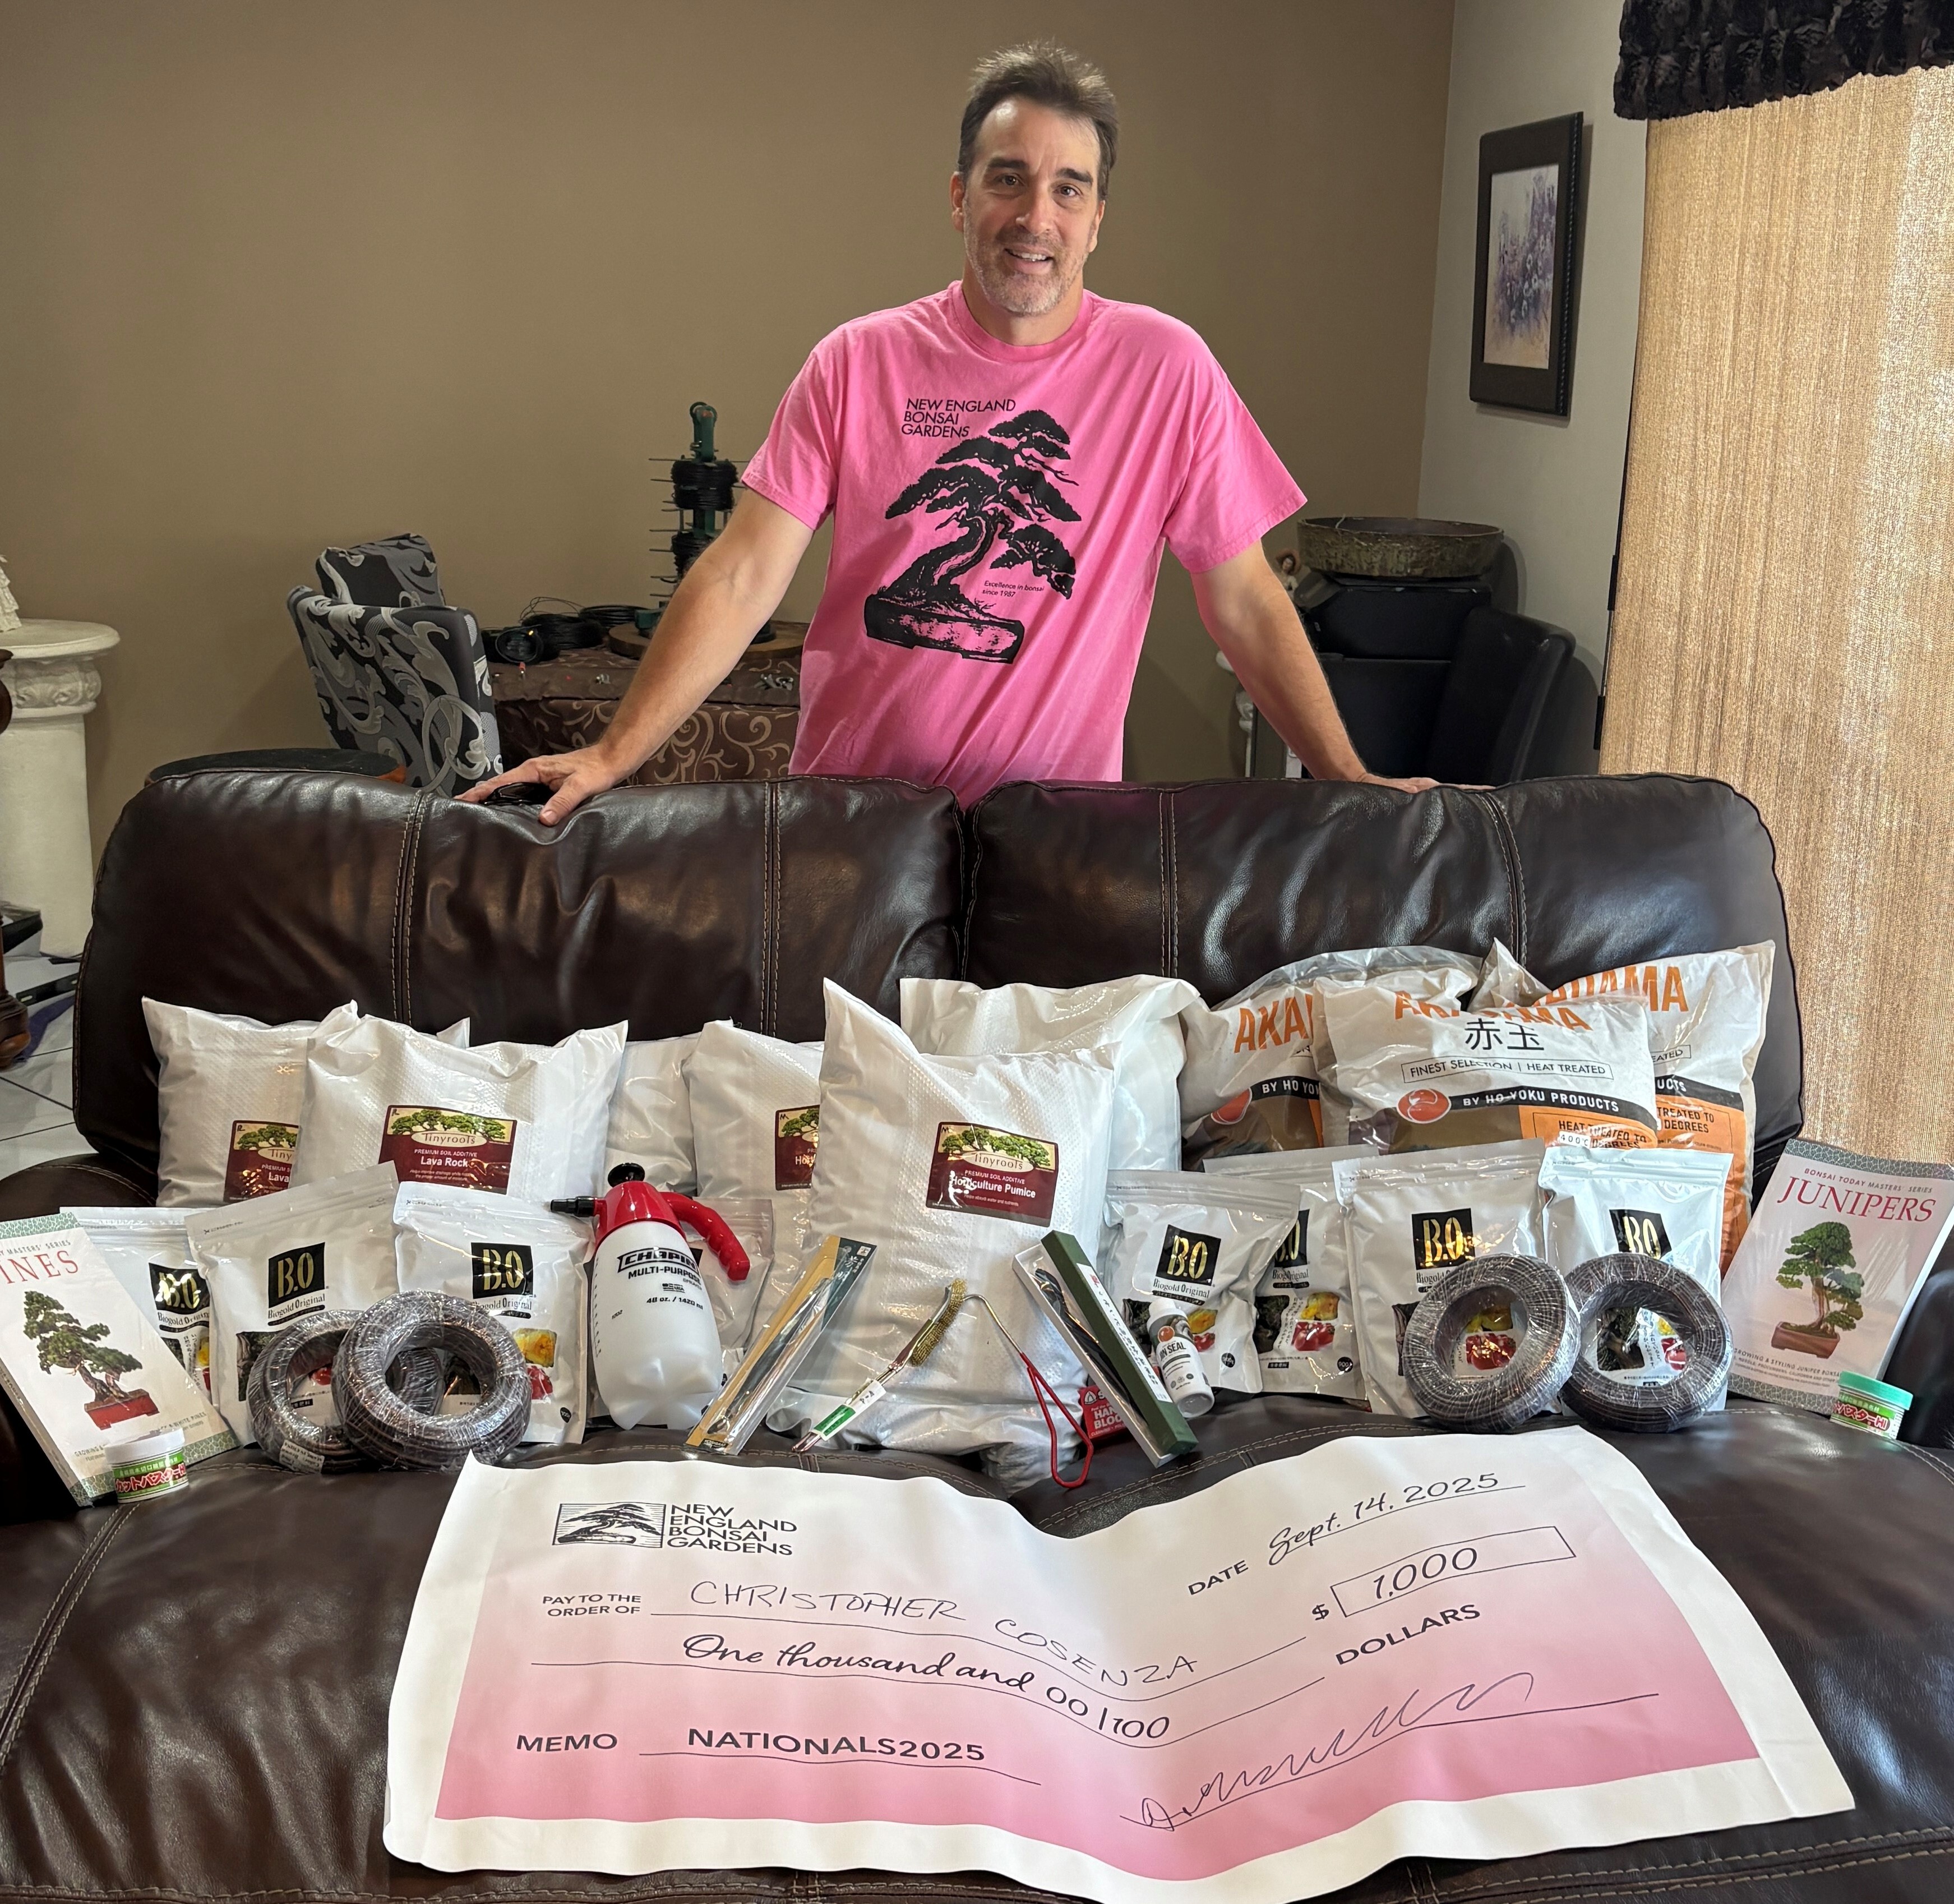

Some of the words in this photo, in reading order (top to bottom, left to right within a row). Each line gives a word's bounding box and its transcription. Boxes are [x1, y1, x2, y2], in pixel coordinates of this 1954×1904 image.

[906, 398, 943, 411] NEW
[945, 399, 1016, 412] ENGLAND
[903, 411, 959, 425] BONSAI
[901, 423, 970, 438] GARDENS
[984, 580, 1016, 589] Excellence
[1464, 1017, 1545, 1050] 赤玉
[1652, 1048, 1683, 1062] EATED
[1410, 1061, 1447, 1078] FINEST
[1450, 1059, 1512, 1071] SELECTION
[1527, 1063, 1554, 1072] HEAT
[1557, 1063, 1606, 1074] TREATED
[1262, 1081, 1277, 1094] BY
[1282, 1080, 1299, 1091] HO
[1302, 1081, 1319, 1095] YO
[1657, 1077, 1687, 1092] UCTS
[1463, 1096, 1479, 1107] BY
[1486, 1094, 1504, 1104] HO
[1510, 1089, 1545, 1101] YOKU
[1550, 1092, 1619, 1113] PRODUCTS
[1657, 1107, 1700, 1120] TREATED
[1703, 1112, 1715, 1123] TO
[1558, 1120, 1585, 1132] HEAT
[1633, 1133, 1647, 1144] TO
[1664, 1119, 1710, 1133] DEGREES
[421, 1132, 477, 1145] Tinyroots
[267, 1149, 293, 1161] Tiny
[421, 1155, 442, 1167] Lava
[445, 1156, 468, 1168] Rock
[973, 1152, 1024, 1170] Tinyroots
[268, 1172, 289, 1183] Lava
[964, 1169, 989, 1179] PREMIUM
[990, 1173, 1001, 1181] SOIL
[1002, 1175, 1025, 1185] ADDITIVE
[1804, 1168, 1836, 1181] BONSAI
[1838, 1175, 1867, 1187] TODAY
[951, 1175, 1003, 1193] Horticulture
[1004, 1183, 1037, 1198] Pumice
[1777, 1176, 1937, 1223] JUNIPERS
[45, 1239, 72, 1250] SERIES
[1622, 1215, 1661, 1260] BO
[624, 1250, 698, 1271] CHAPIN
[1167, 1234, 1208, 1279] B.O
[277, 1252, 315, 1298] B.O
[483, 1248, 525, 1290] B.O
[628, 1265, 702, 1285] MULTI-PURPOSE
[1153, 1278, 1180, 1292] Biogold
[1181, 1284, 1210, 1299] Original
[268, 1302, 294, 1318] Biogold
[295, 1293, 325, 1310] Original
[474, 1300, 501, 1311] ogold
[678, 1297, 695, 1306] 1420
[157, 1311, 184, 1326] Biogold
[184, 1311, 210, 1325] Origin
[1167, 1341, 1186, 1354] SEAL
[1770, 1359, 1796, 1370] STYLING
[1796, 1365, 1821, 1374] JUNIPER
[1094, 1405, 1115, 1419] HAN
[1094, 1414, 1122, 1429] BLOC
[671, 1504, 735, 1518] NEW
[1268, 1512, 1342, 1566] Sept.
[1403, 1472, 1499, 1504] 2025
[670, 1515, 798, 1533] ENGLAND
[668, 1526, 768, 1542] BONSAI
[667, 1537, 793, 1556] GARDENS
[1187, 1559, 1249, 1596] DATE
[1311, 1603, 1329, 1621] $
[1372, 1547, 1478, 1601] 1,000
[542, 1596, 577, 1605] PAY
[578, 1594, 603, 1603] TO
[607, 1594, 641, 1603] THE
[547, 1605, 610, 1617] ORDER
[615, 1605, 641, 1615] OF
[690, 1580, 967, 1622] CHRISTOPHER
[994, 1619, 1198, 1688] COSENZA
[1335, 1603, 1481, 1666] DOLLARS
[683, 1634, 764, 1664] One
[777, 1642, 957, 1677] thousand
[955, 1672, 1036, 1693] and
[516, 1732, 618, 1753] MEMO
[687, 1727, 986, 1762] NATIONALS2025
